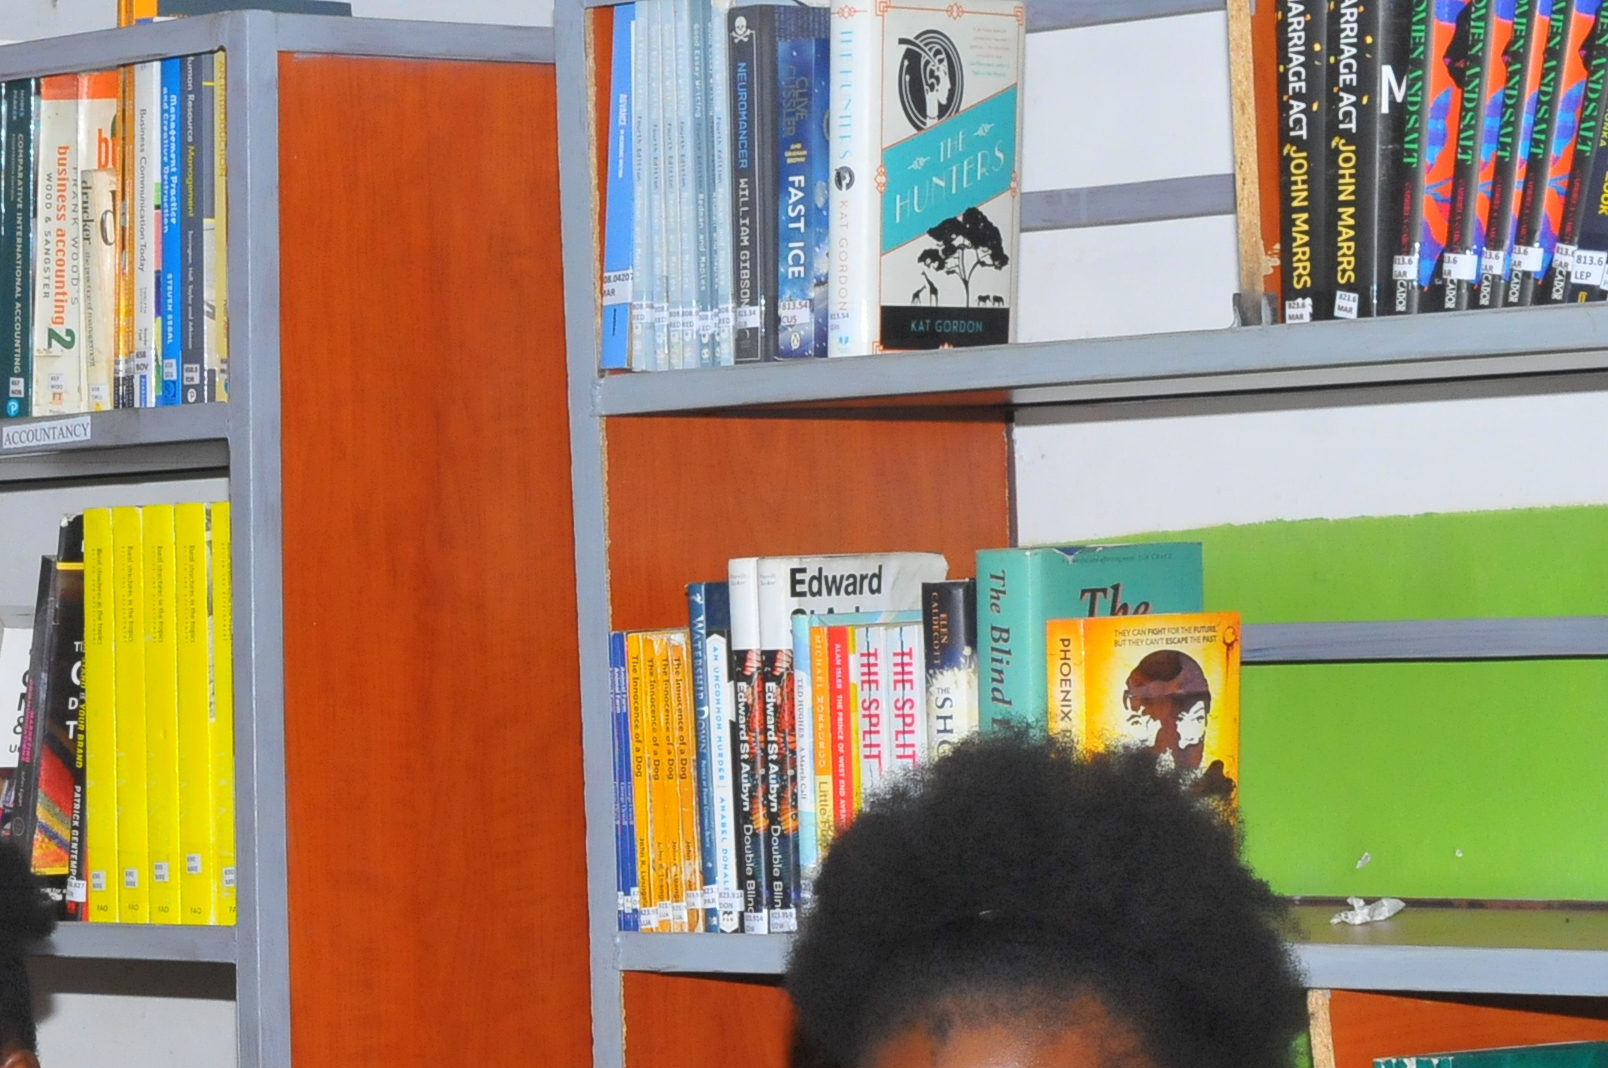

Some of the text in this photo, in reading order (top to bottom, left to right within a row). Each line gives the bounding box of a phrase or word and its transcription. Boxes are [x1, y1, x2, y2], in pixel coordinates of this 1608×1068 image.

[795, 76, 809, 121] CLIVE
[839, 31, 853, 159] THE HUNTERS
[940, 129, 966, 163] THE
[1286, 0, 1312, 289] ARRIAGE ACT JOHN MARRS
[1337, 0, 1358, 285] ARRIAGE ACT JOHN MARRS
[45, 173, 53, 210] WOOD
[139, 156, 147, 239] Communication
[737, 62, 751, 308] NEUROMANCER WILLIAM GIBSON
[896, 139, 1005, 223] HUNTERS
[81, 180, 94, 245] drucker
[788, 175, 805, 279] FAST ICE
[15, 211, 23, 299] INTERNATIONAL
[43, 231, 51, 299] SANGSTER
[48, 145, 76, 350] business accounting 2
[138, 242, 147, 272] Today
[839, 201, 849, 311] KAT GORDON
[1575, 254, 1604, 267] 813.6
[1575, 271, 1592, 281] LEP
[781, 315, 797, 324] CUS
[911, 319, 984, 333] KAT GORDON
[1337, 305, 1354, 315] MAR
[14, 302, 22, 374] ACCOUNTING
[4, 422, 90, 447] ACCOUNTANCY
[790, 564, 882, 598] Edward
[713, 646, 718, 660] AN
[931, 592, 939, 665] CALDECOTT
[940, 613, 948, 643] ELEN
[989, 569, 1013, 707] The Blind
[1114, 628, 1130, 637] THEY
[1132, 627, 1146, 636] CAN
[1148, 627, 1166, 636] FIGHT
[1167, 626, 1179, 635] FOR
[1180, 626, 1192, 634] THE
[1114, 635, 1217, 647] BUT THEY CAN'T ESCAPE THE PAST
[692, 616, 709, 753] WATERSHIP DOWN
[714, 667, 723, 731] UNCOMMON
[815, 634, 826, 768] MICHAEL MORPURGO
[860, 648, 882, 767] THE SPLIT
[893, 647, 917, 768] THE SPLIT
[1059, 638, 1072, 722] PHOENIX
[737, 682, 749, 741] Edward
[75, 735, 84, 768] BRAND
[716, 736, 725, 781] MURDER
[740, 743, 749, 760] St
[741, 763, 750, 812] Aubyn
[819, 781, 827, 817] Little
[719, 797, 727, 842] ANABEL
[743, 824, 754, 876] Double
